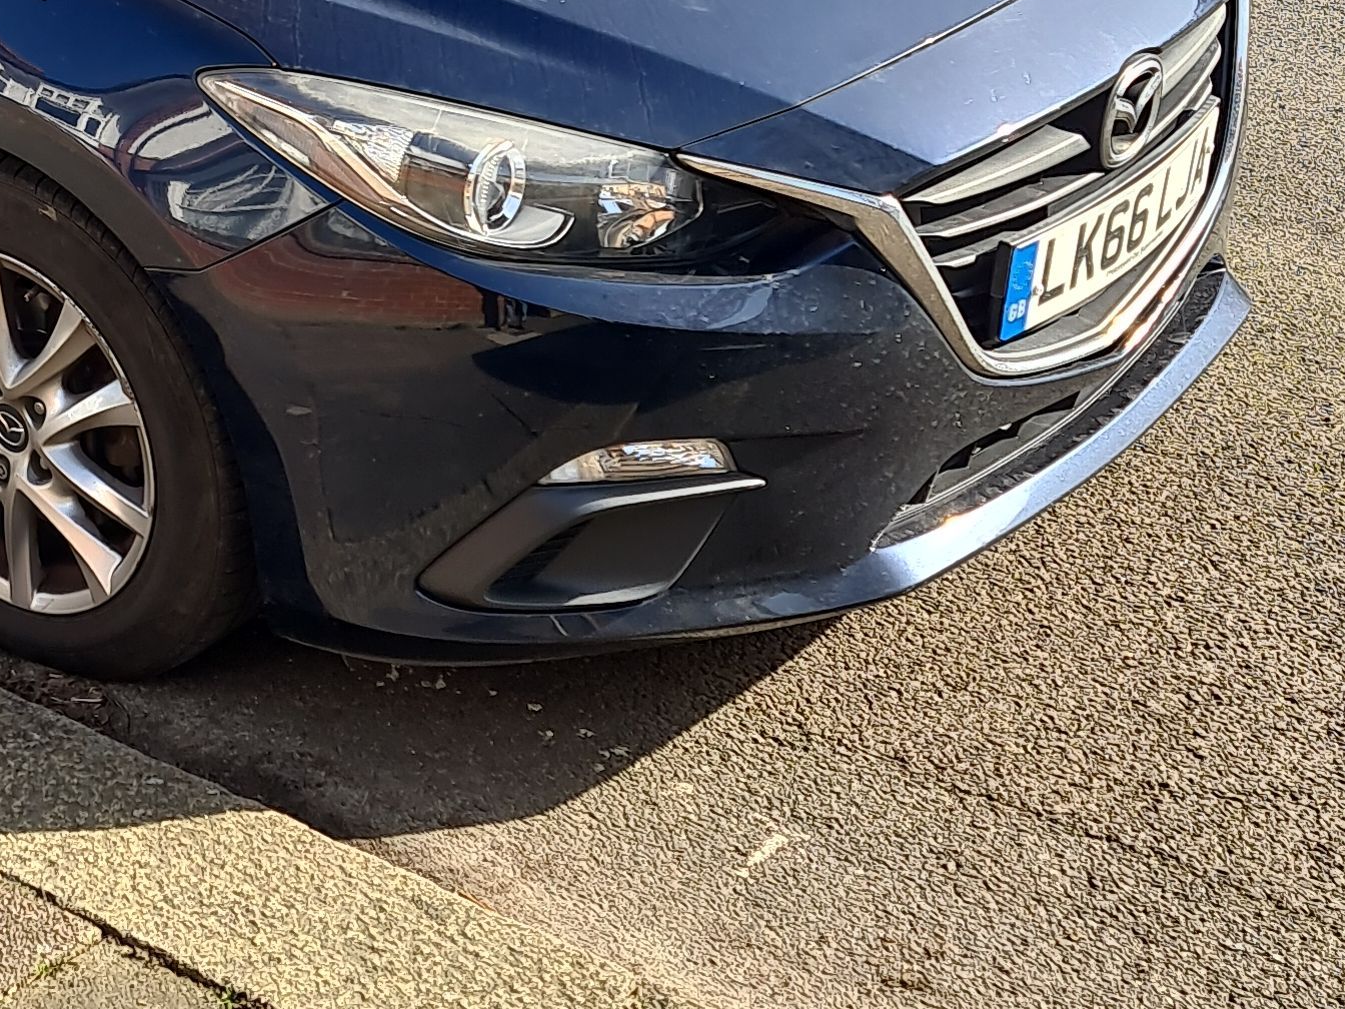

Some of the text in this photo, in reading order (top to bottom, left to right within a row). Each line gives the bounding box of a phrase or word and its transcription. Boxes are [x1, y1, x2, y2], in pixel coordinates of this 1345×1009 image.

[1038, 127, 1209, 307] LK66 LJA
[1007, 298, 1027, 322] GB
